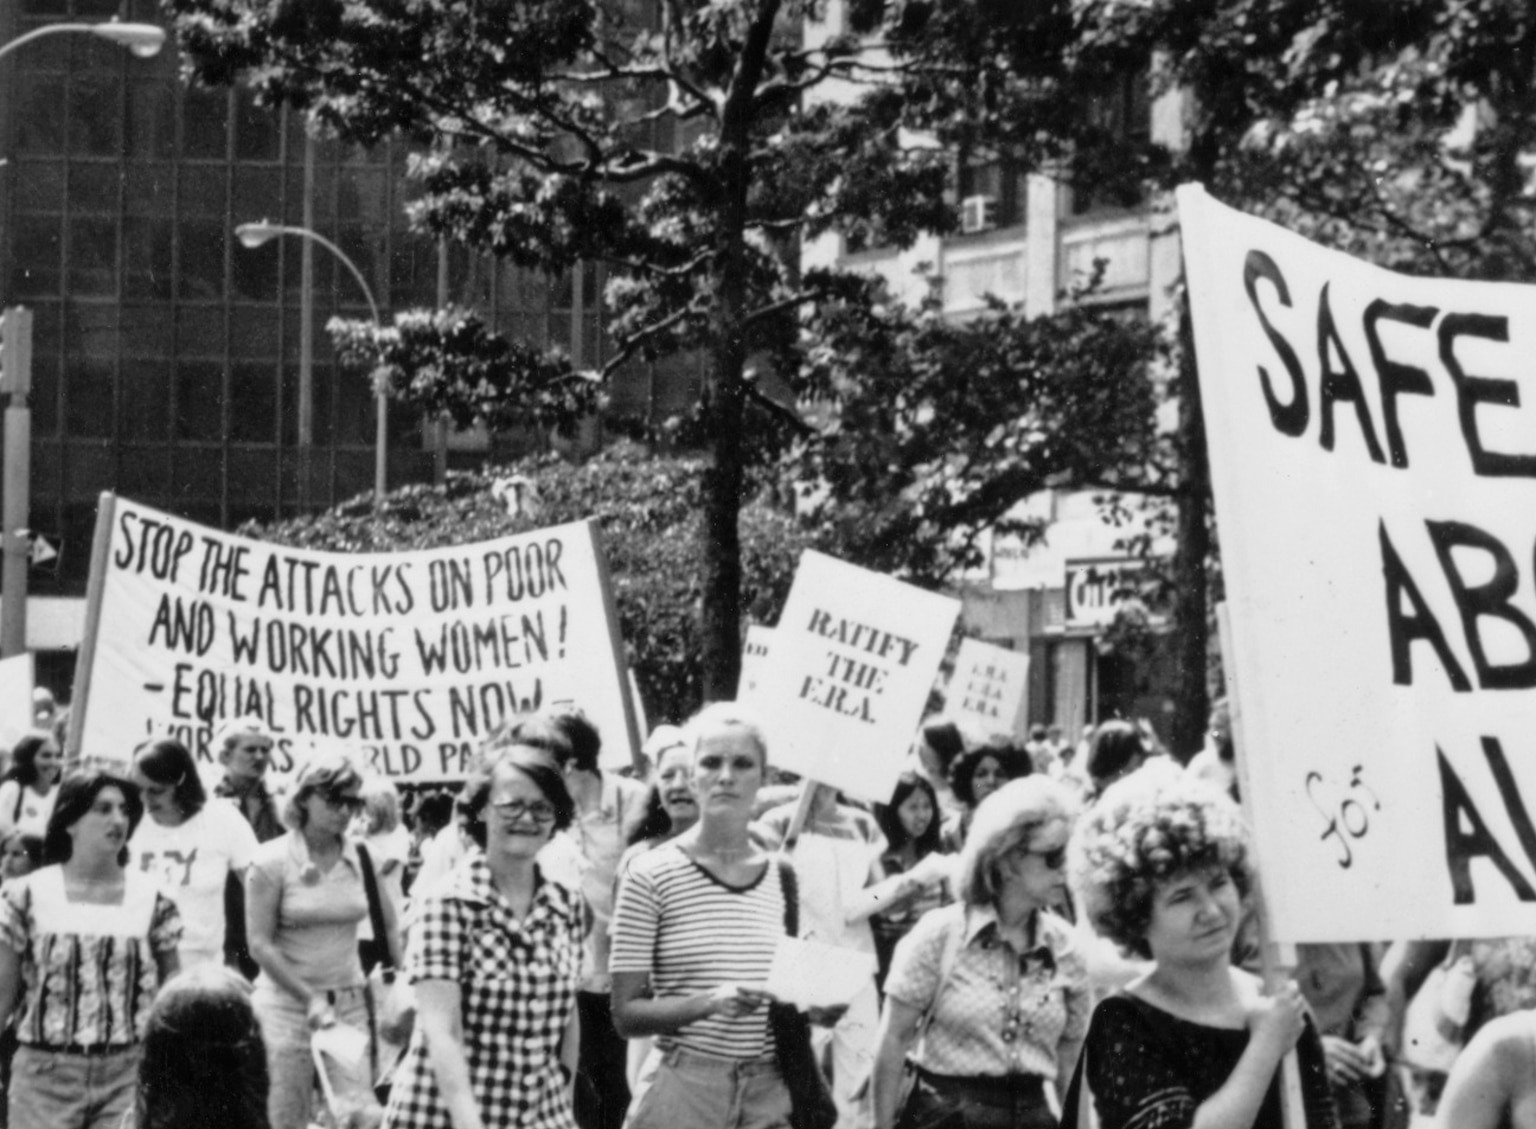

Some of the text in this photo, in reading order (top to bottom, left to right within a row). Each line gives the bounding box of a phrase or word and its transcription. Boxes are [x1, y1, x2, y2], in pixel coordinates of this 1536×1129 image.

[114, 510, 568, 617] STOP THE ATTACKS ON POOR
[149, 593, 215, 657] AND
[227, 608, 401, 681] WORKING
[807, 608, 920, 666] RATIFY
[827, 651, 889, 693] THE
[293, 684, 437, 741] RIGHTS
